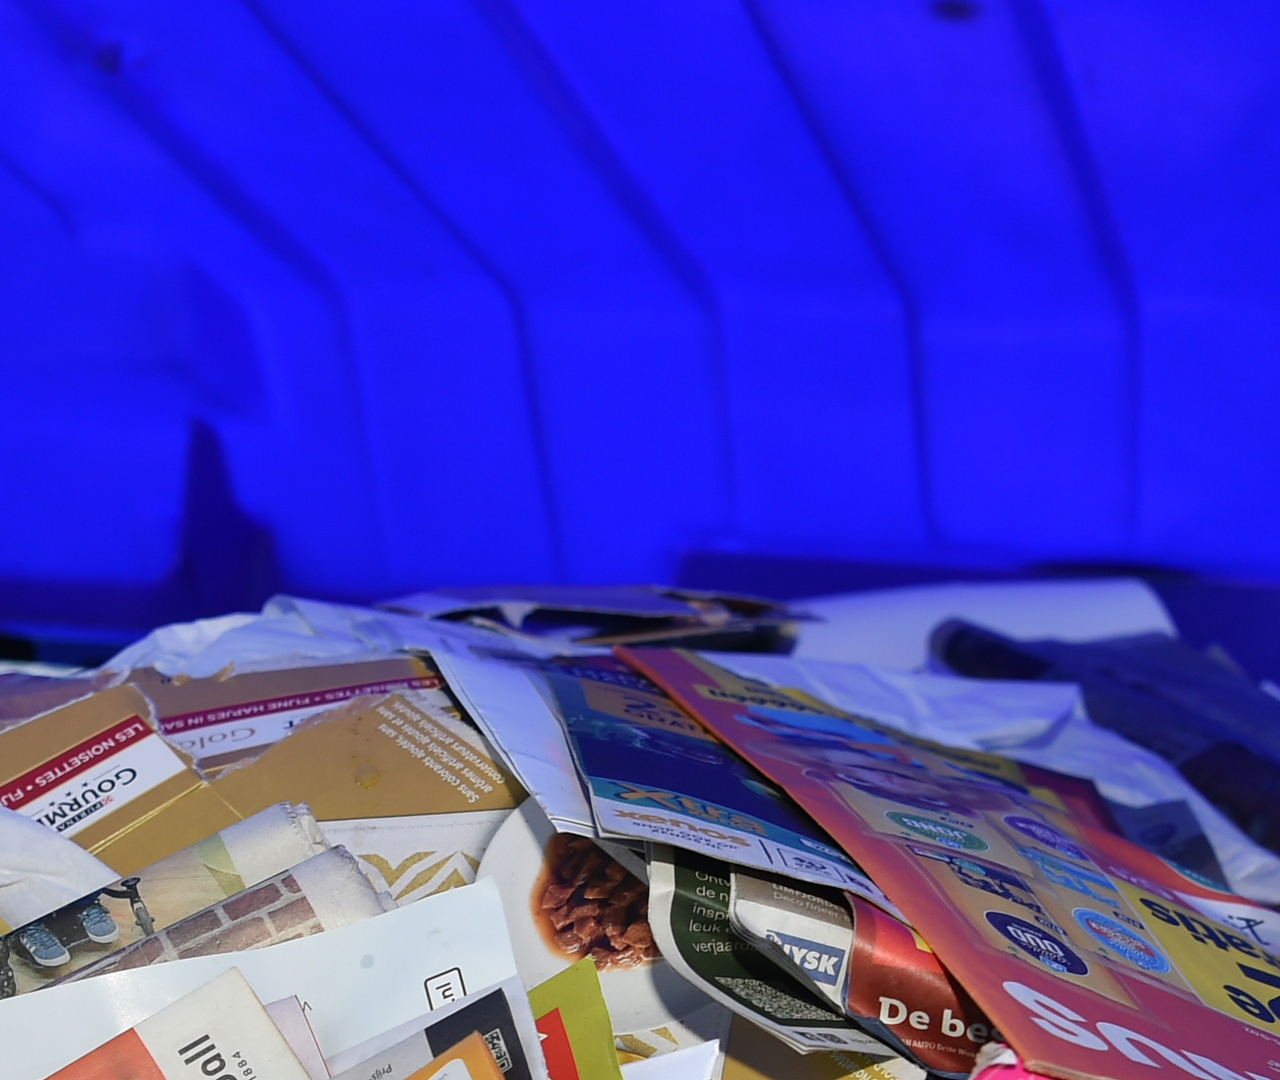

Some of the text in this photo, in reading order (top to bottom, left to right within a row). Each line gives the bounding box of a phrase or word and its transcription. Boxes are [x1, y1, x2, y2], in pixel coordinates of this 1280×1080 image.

[188, 715, 204, 725] IN
[209, 704, 264, 717] HAPJES
[419, 719, 455, 744] artificiels
[35, 723, 144, 787] LES NOISETTES
[376, 706, 493, 793] arômes artificiels ajoutés et sans
[378, 723, 479, 803] Sans colorants ajoutés, sans
[451, 742, 505, 784] conservateurs
[56, 800, 104, 832] PURINA
[613, 809, 751, 847] xenos
[696, 886, 715, 899] de
[773, 891, 801, 908] Deco
[689, 920, 720, 933] leuk
[1007, 925, 1065, 957] OUD
[780, 942, 840, 976] JYSK
[879, 996, 930, 1031] De
[937, 1043, 957, 1053] Beste
